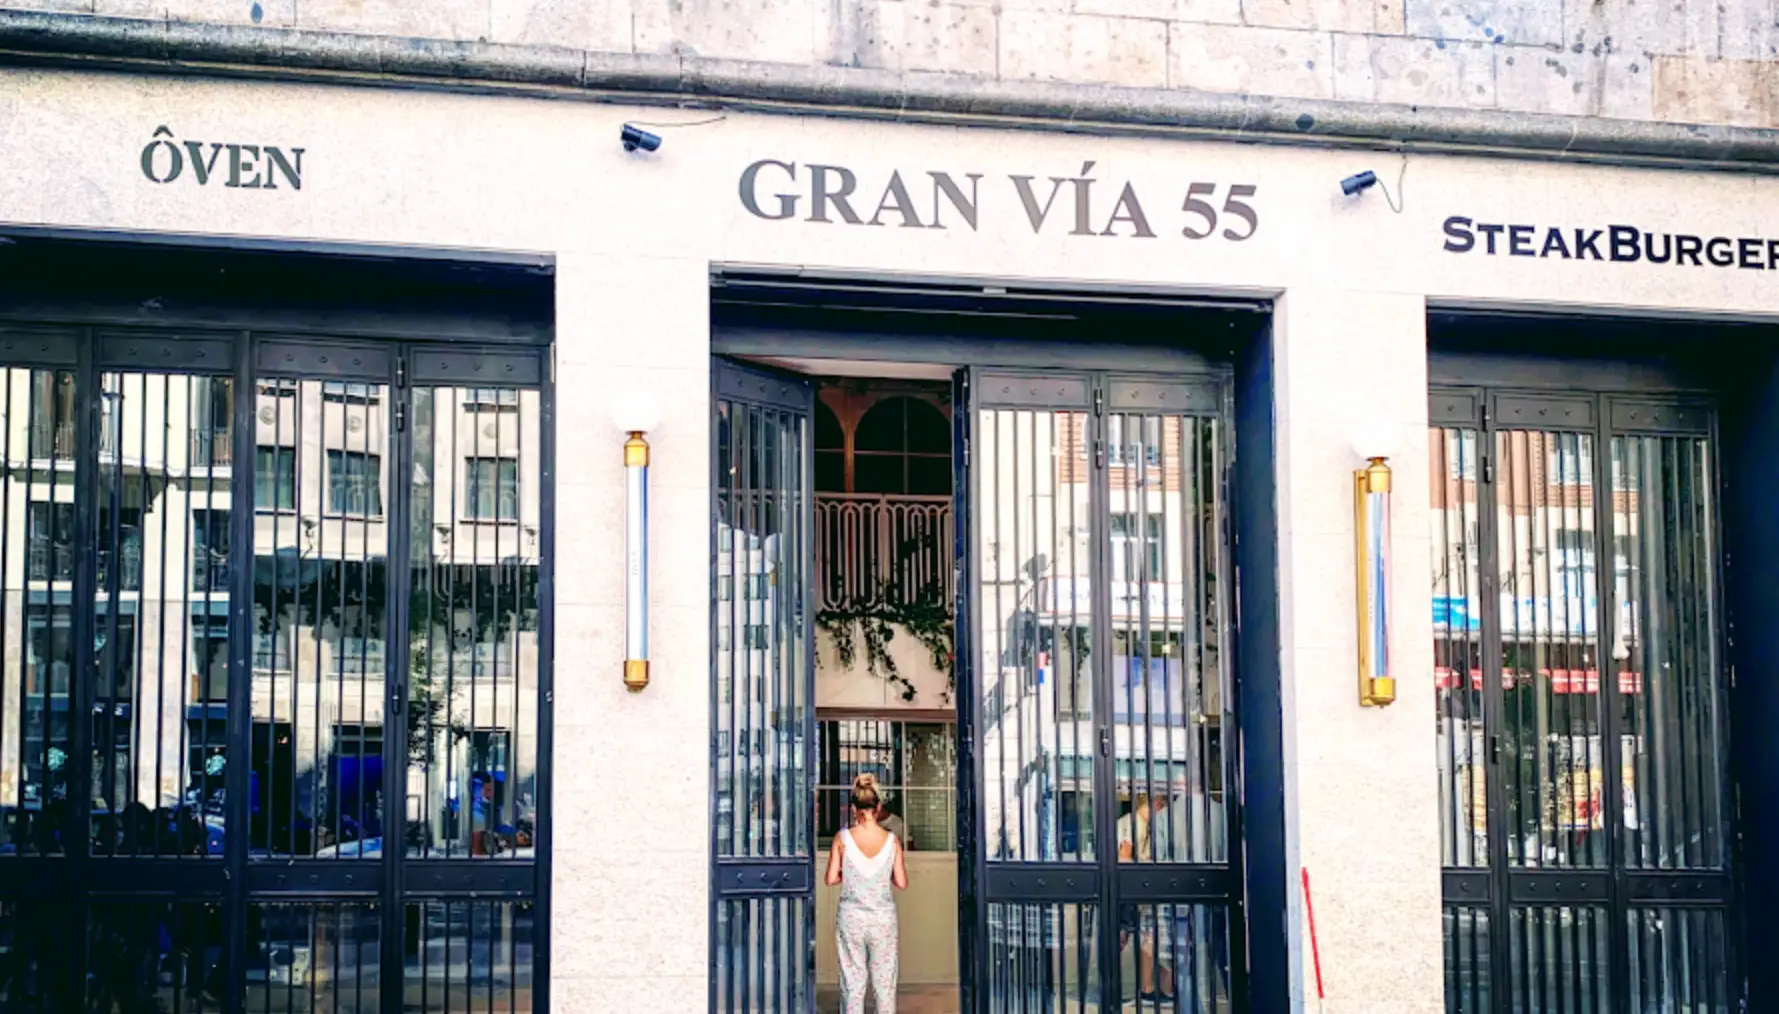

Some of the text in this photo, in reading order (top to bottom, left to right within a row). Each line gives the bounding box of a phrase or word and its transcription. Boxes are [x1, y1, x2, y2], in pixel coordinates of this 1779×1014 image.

[140, 124, 306, 191] ÔVEN
[738, 159, 1259, 241] GRAN VÍA 55
